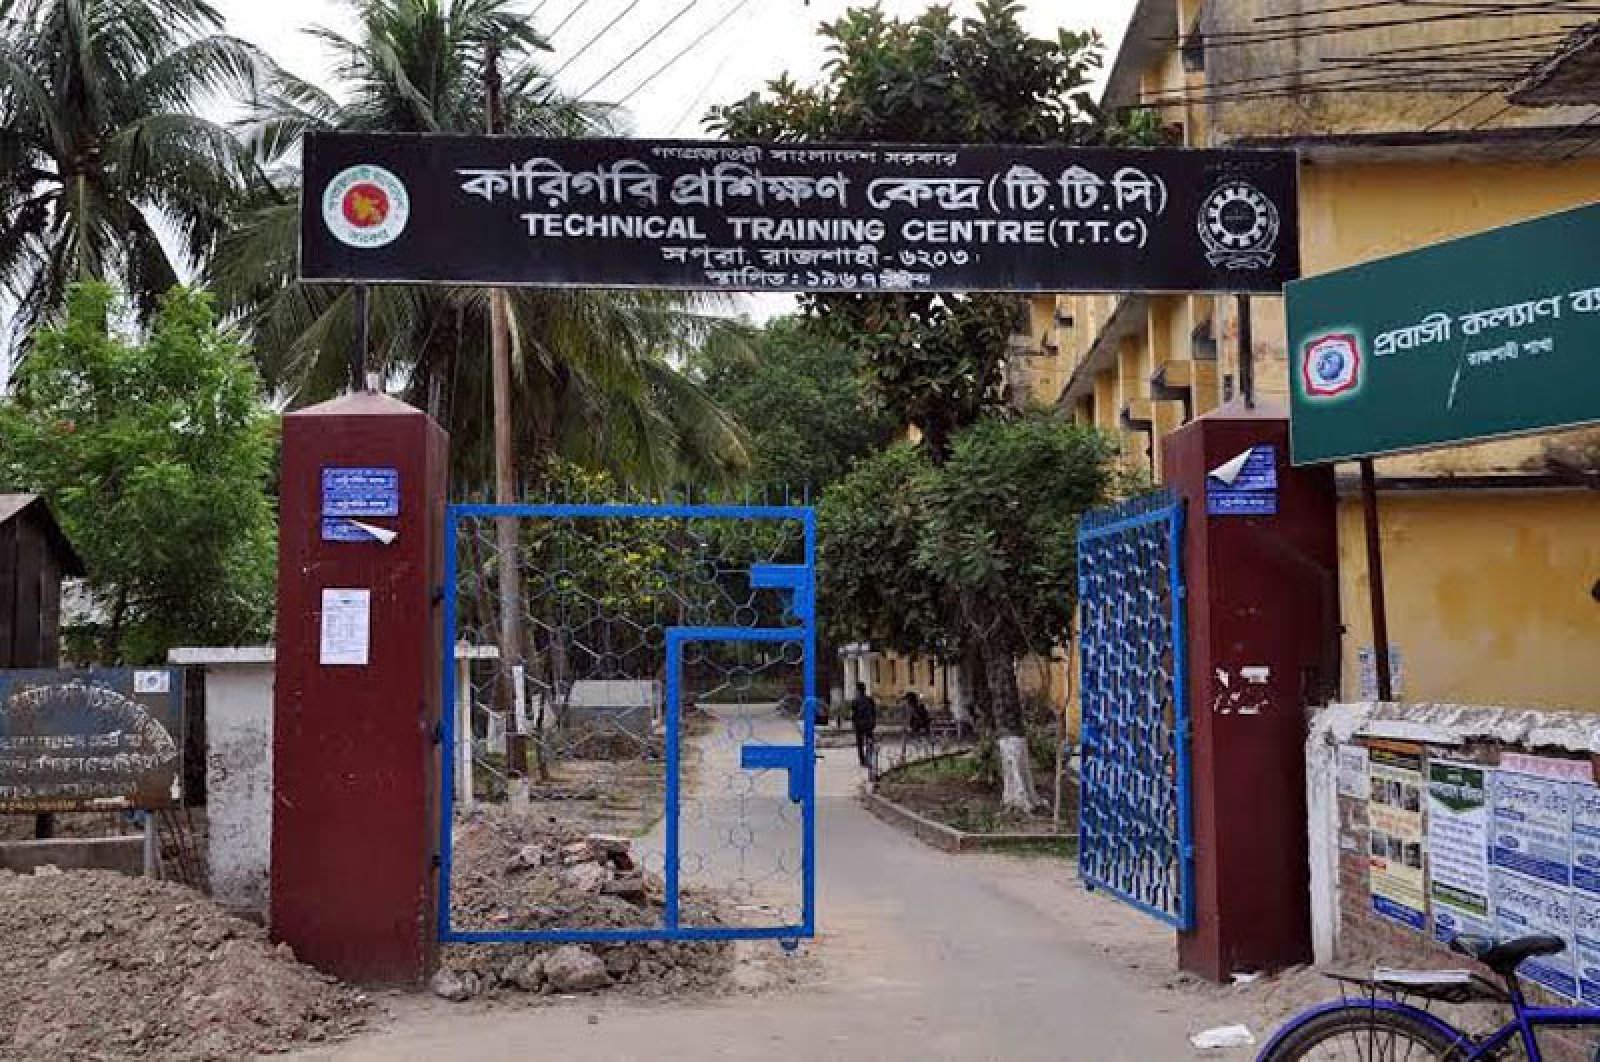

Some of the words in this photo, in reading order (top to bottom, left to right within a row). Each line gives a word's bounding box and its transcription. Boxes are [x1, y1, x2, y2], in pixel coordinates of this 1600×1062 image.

[669, 161, 850, 208] প্রশিক্ষণ
[521, 213, 706, 239] TECHNICAL
[727, 216, 886, 242] TRAINING
[899, 250, 969, 268] ৬২০৩
[1373, 312, 1452, 357] প্রবাসী
[1458, 295, 1562, 335] কল্যাণ
